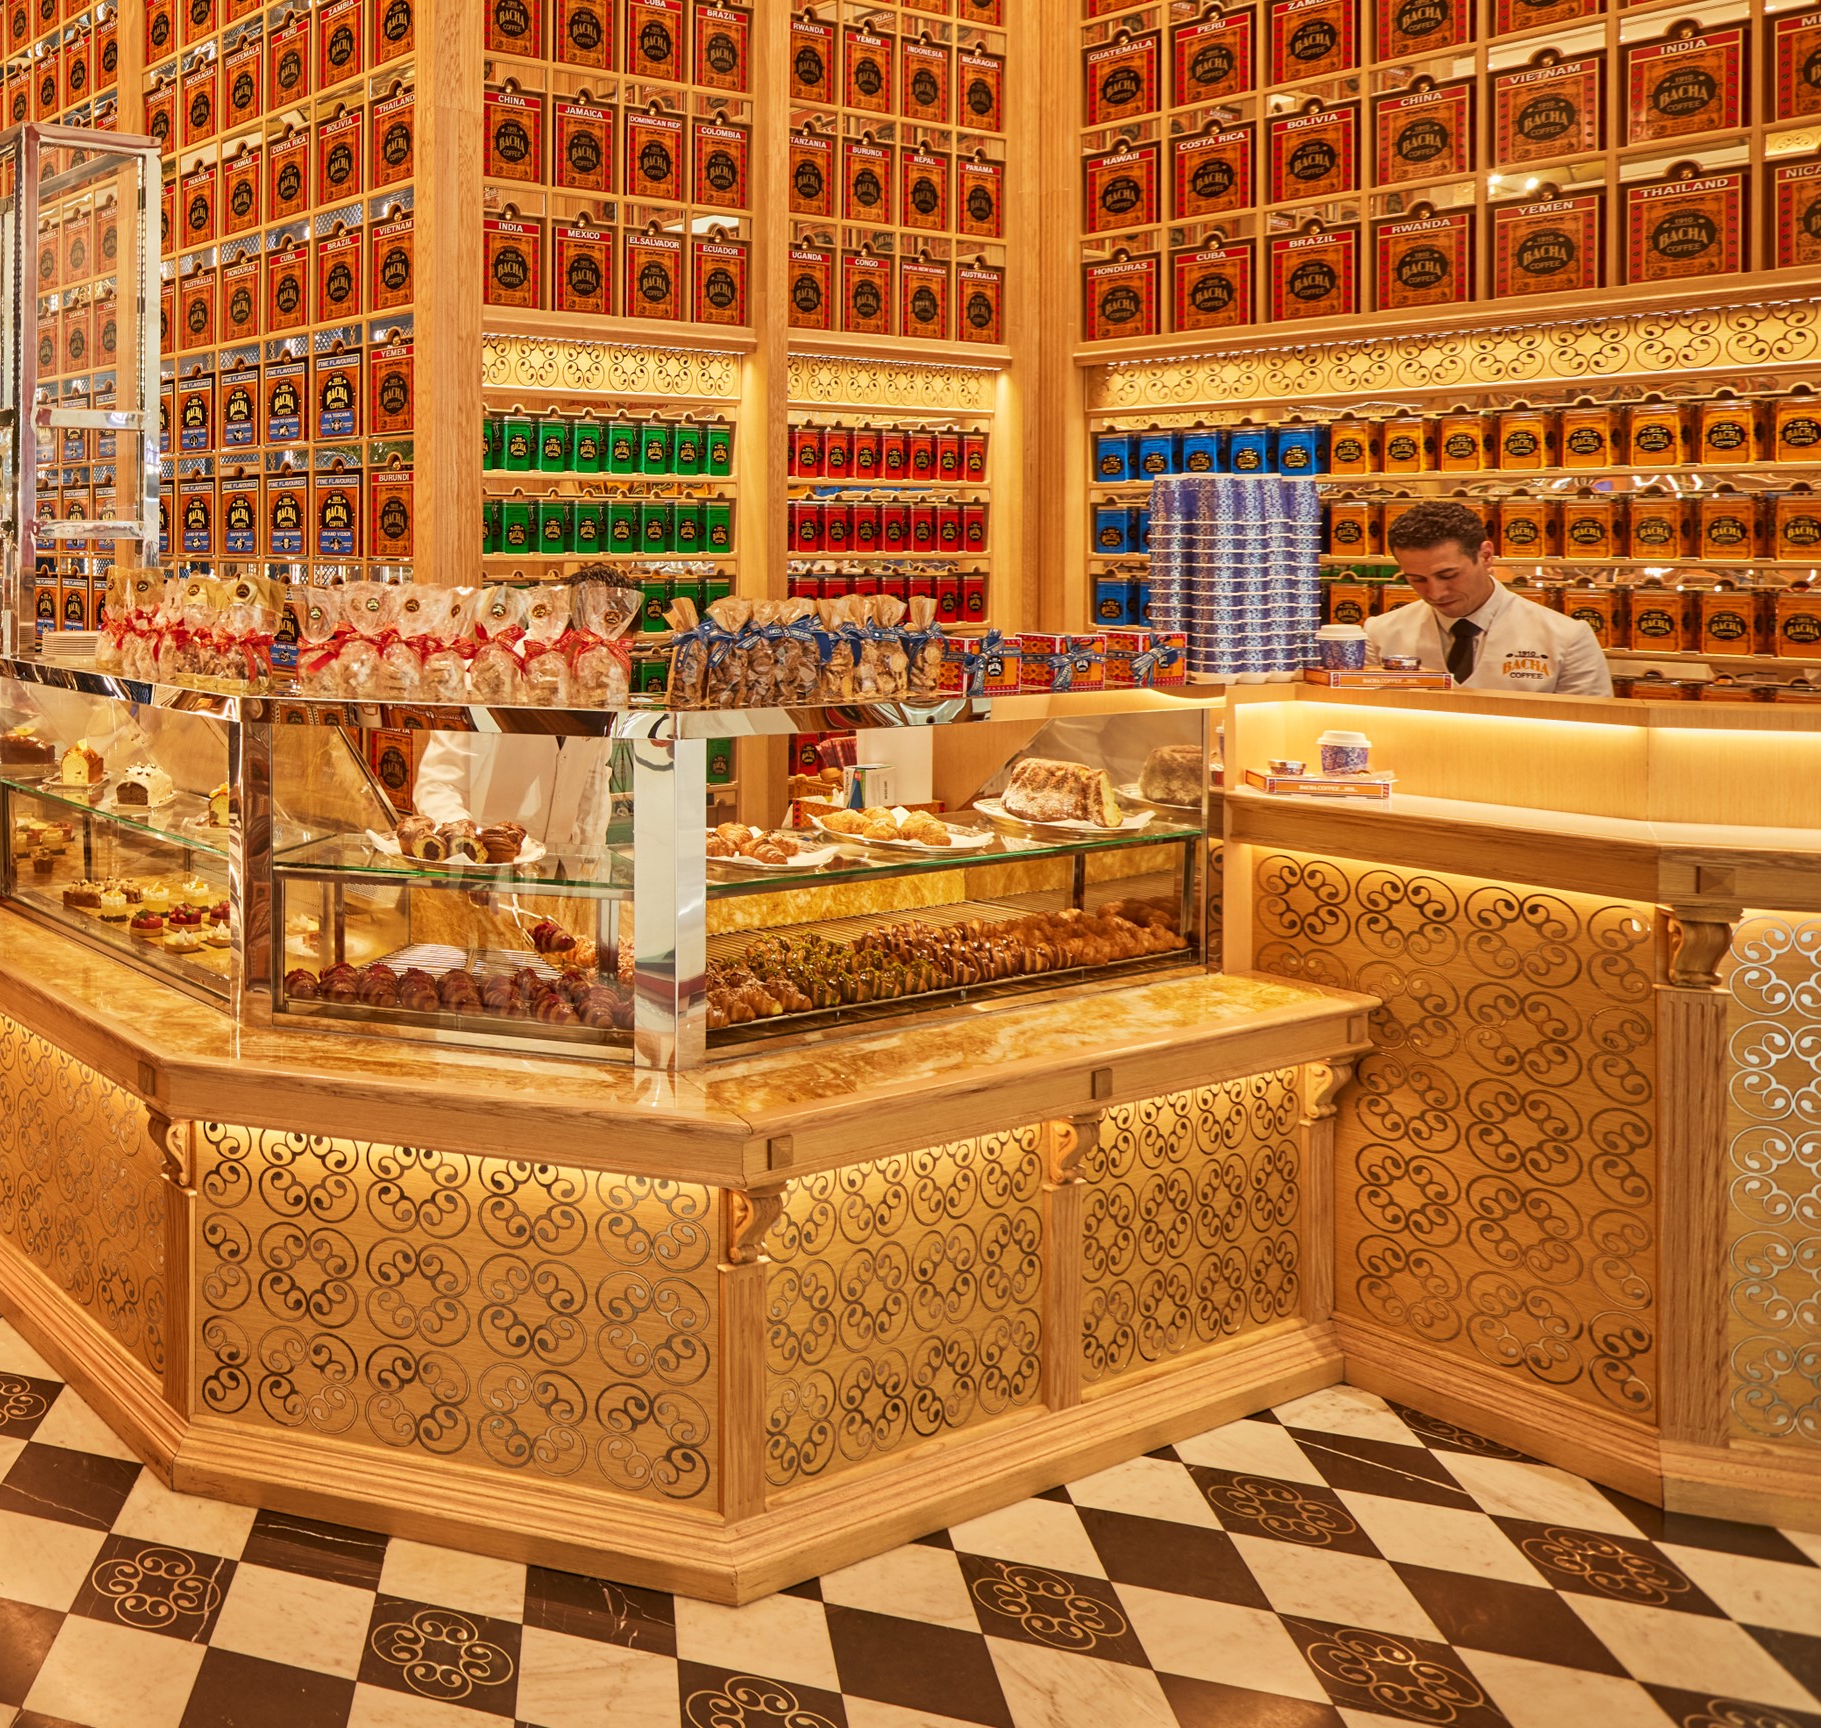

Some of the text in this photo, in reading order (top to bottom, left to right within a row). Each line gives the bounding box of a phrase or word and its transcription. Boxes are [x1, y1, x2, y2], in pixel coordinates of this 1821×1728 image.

[328, 0, 354, 17] ZAMBIA
[706, 8, 737, 21] BRAZIL
[281, 26, 298, 39] PERU
[793, 22, 825, 35] RWANDA
[1197, 21, 1226, 33] PERU
[856, 34, 881, 46] YEMEN
[1660, 38, 1707, 55] INDIA
[226, 46, 260, 67] GUATEMALA
[907, 46, 943, 59] INDONESIA
[1089, 40, 1153, 62] GUATEMALA
[962, 56, 998, 69] NICARAGUA
[1509, 64, 1581, 85] VIETNAM
[1674, 73, 1694, 83] 1910
[498, 95, 526, 106] CHINA
[1399, 92, 1443, 107] CHINA
[1659, 83, 1709, 108] BACHA
[378, 95, 415, 115] THAILAND
[1666, 100, 1702, 113] COFFEE
[565, 106, 603, 119] JAMAICA
[326, 118, 353, 134] BOLIVIA
[630, 116, 681, 129] DOMINICAN REP
[1286, 113, 1338, 129] BOLIVIA
[1524, 110, 1569, 133] BACHA
[701, 127, 742, 140] COLOMBIA
[1530, 124, 1562, 137] COFFEE
[272, 135, 307, 155] COSTA RICA
[790, 137, 826, 149] TANZANIA
[1179, 131, 1245, 151] COSTA RICA
[852, 146, 883, 157] BURUNDI
[233, 157, 253, 170] HAWAII
[913, 155, 936, 165] NEPAL
[1102, 153, 1140, 166] HAWAII
[965, 163, 994, 174] PANAMA
[188, 173, 210, 187] PANAMA
[1640, 178, 1729, 198] THAILAND
[1518, 201, 1574, 216] YEMEN
[1390, 218, 1452, 235] RWANDA
[1674, 216, 1694, 224] 1910
[379, 221, 413, 235] VIETNAM
[498, 222, 523, 233] INDIA
[567, 229, 600, 240] MEXICO
[1659, 227, 1709, 248] BACHA
[327, 237, 352, 251] BRAZIL
[629, 236, 680, 249] EL SALVADOR
[1289, 235, 1337, 248] BRAZIL
[1666, 242, 1702, 253] COFFEE
[703, 244, 738, 256] ECUADOR
[792, 251, 823, 262] UGANDA
[1196, 251, 1226, 261] CUBA
[1522, 244, 1568, 266] BACHA
[280, 253, 296, 263] CUBA
[855, 258, 879, 268] CONGO
[1529, 259, 1562, 270] COFFEE
[227, 264, 256, 278] HONDURAS
[928, 267, 946, 275] GUINEA
[960, 270, 998, 281] AUSTRALIA
[1093, 262, 1148, 276] HONDURAS
[184, 276, 213, 290] AUSTRALIA
[381, 347, 407, 358] YEMEN
[318, 357, 358, 368] FINE FLAVOURED
[232, 372, 256, 381] FLAVOURED
[266, 365, 303, 377] FINE FLAVOURED
[1639, 433, 1669, 446] BACHA
[1711, 431, 1743, 445] BACHA
[1785, 428, 1818, 442] BACHA
[1509, 439, 1535, 450] BACHA
[1570, 436, 1600, 449] BACHA
[278, 479, 305, 487] FLAVOURED
[379, 473, 410, 482] BURUNDI
[233, 481, 256, 489] FLAVOURED
[1639, 526, 1670, 540] BACHA
[1711, 525, 1742, 540] BACHA
[1787, 525, 1820, 540] BACHA
[1640, 619, 1670, 632] BACHA
[1711, 621, 1742, 633] BACHA
[1787, 624, 1820, 636] BACHA
[1502, 658, 1550, 676] BACHA
[1510, 671, 1544, 679] COFFEE
